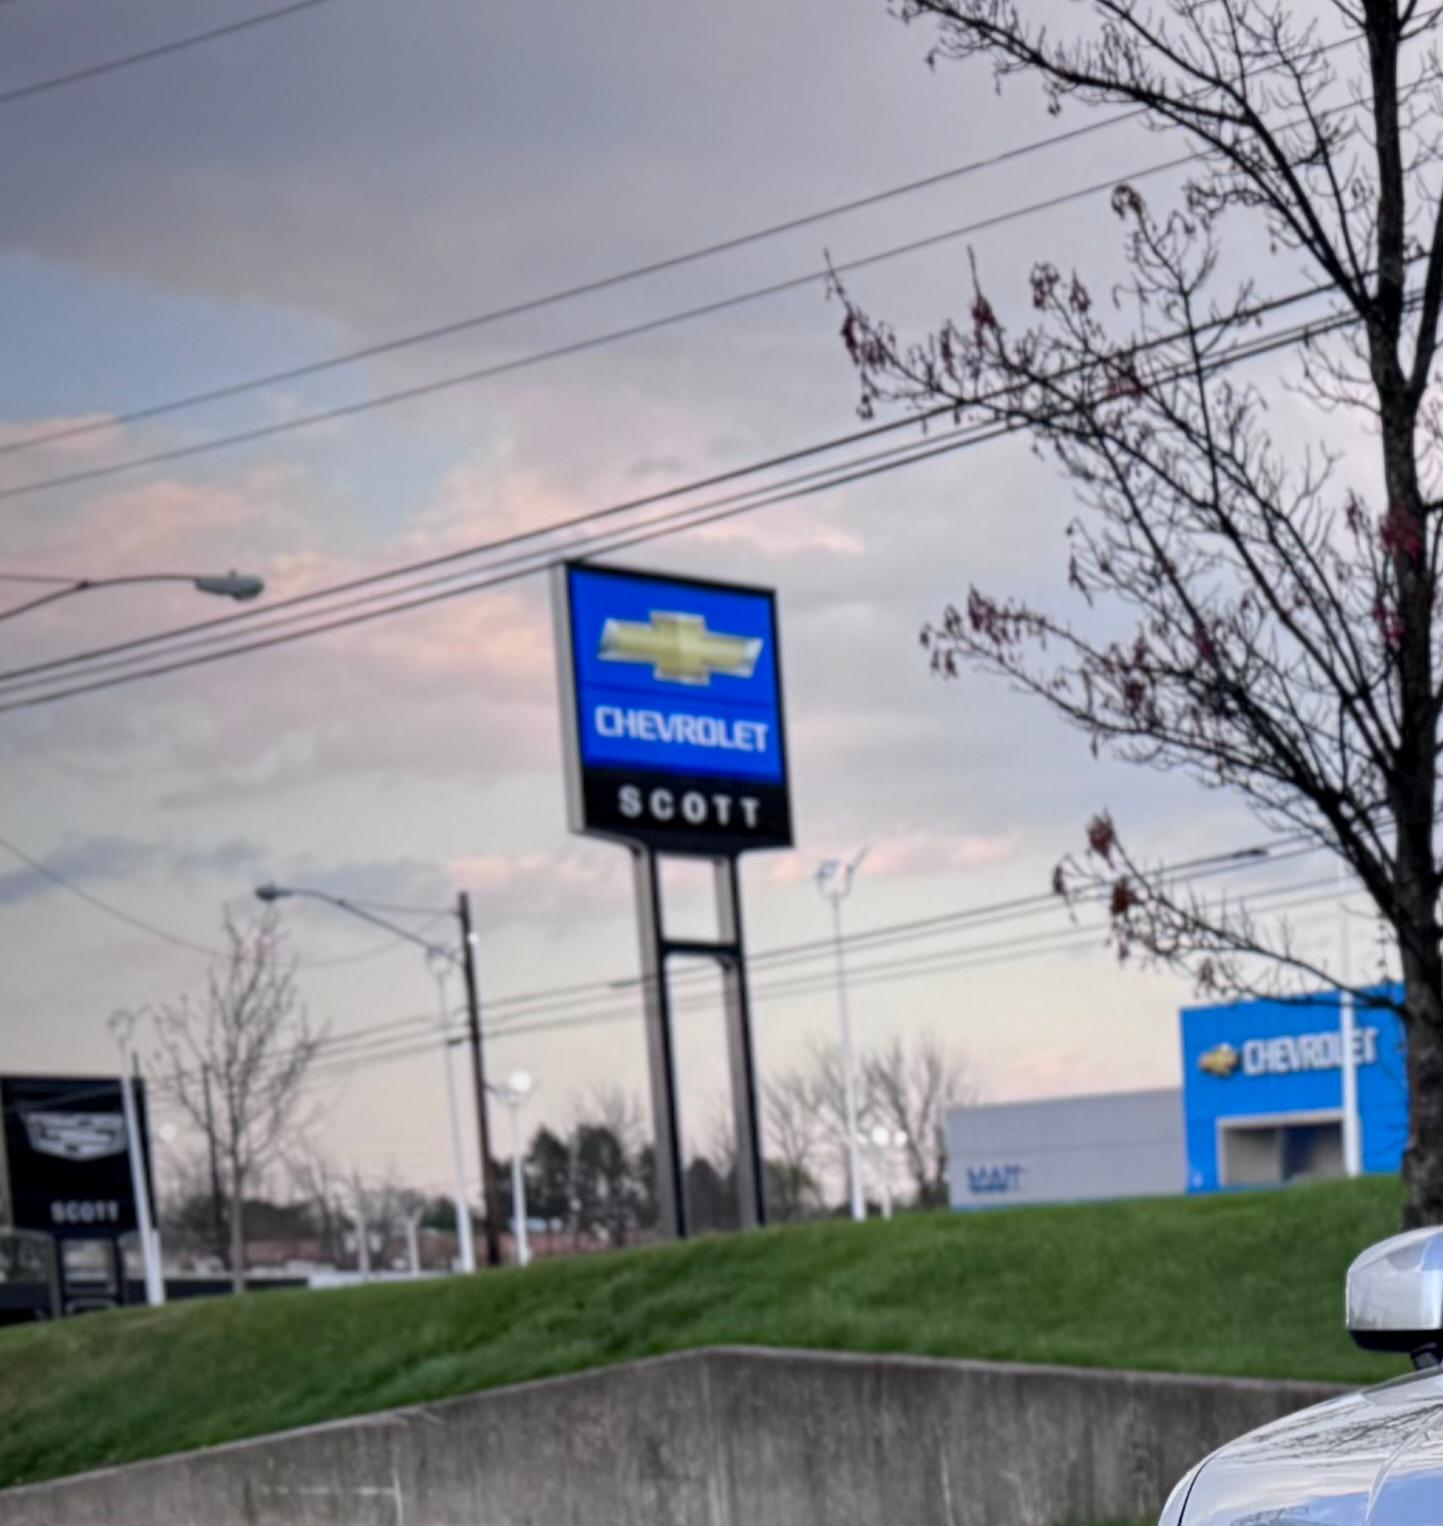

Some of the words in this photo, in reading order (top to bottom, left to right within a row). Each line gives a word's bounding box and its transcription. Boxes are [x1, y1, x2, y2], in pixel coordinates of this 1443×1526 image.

[595, 705, 768, 752] CHEVROLET
[618, 784, 760, 828] SCOTT
[51, 1201, 119, 1223] SCOTT
